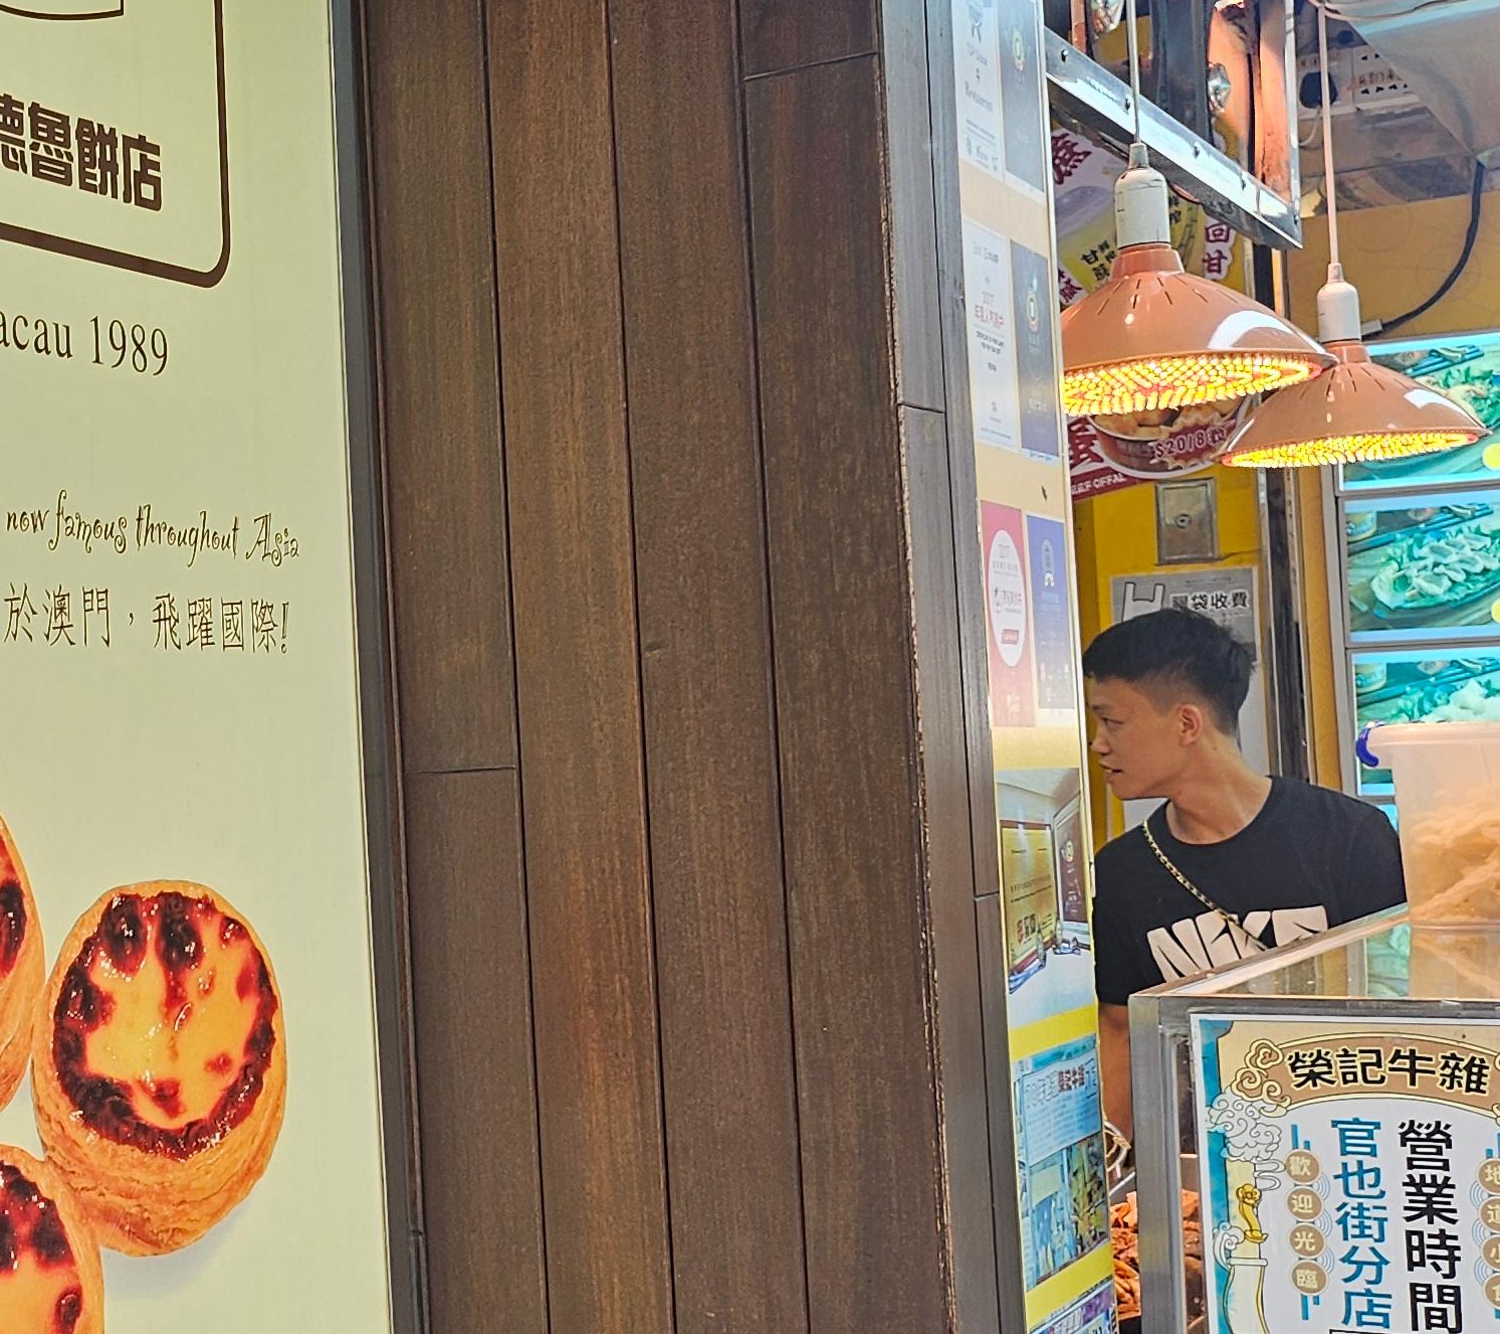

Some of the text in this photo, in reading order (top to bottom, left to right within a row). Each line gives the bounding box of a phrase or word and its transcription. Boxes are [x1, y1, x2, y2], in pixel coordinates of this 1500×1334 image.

[90, 315, 169, 377] 1989
[6, 507, 51, 533] now
[47, 488, 129, 554] famous
[135, 503, 240, 569] throughout
[245, 513, 301, 568] Asia
[1287, 1047, 1491, 1095] 榮記牛雜
[1289, 1154, 1319, 1290] 歡迎光臨
[1330, 1116, 1393, 1331] 官也街分店
[1397, 1118, 1465, 1334] 營業時間
